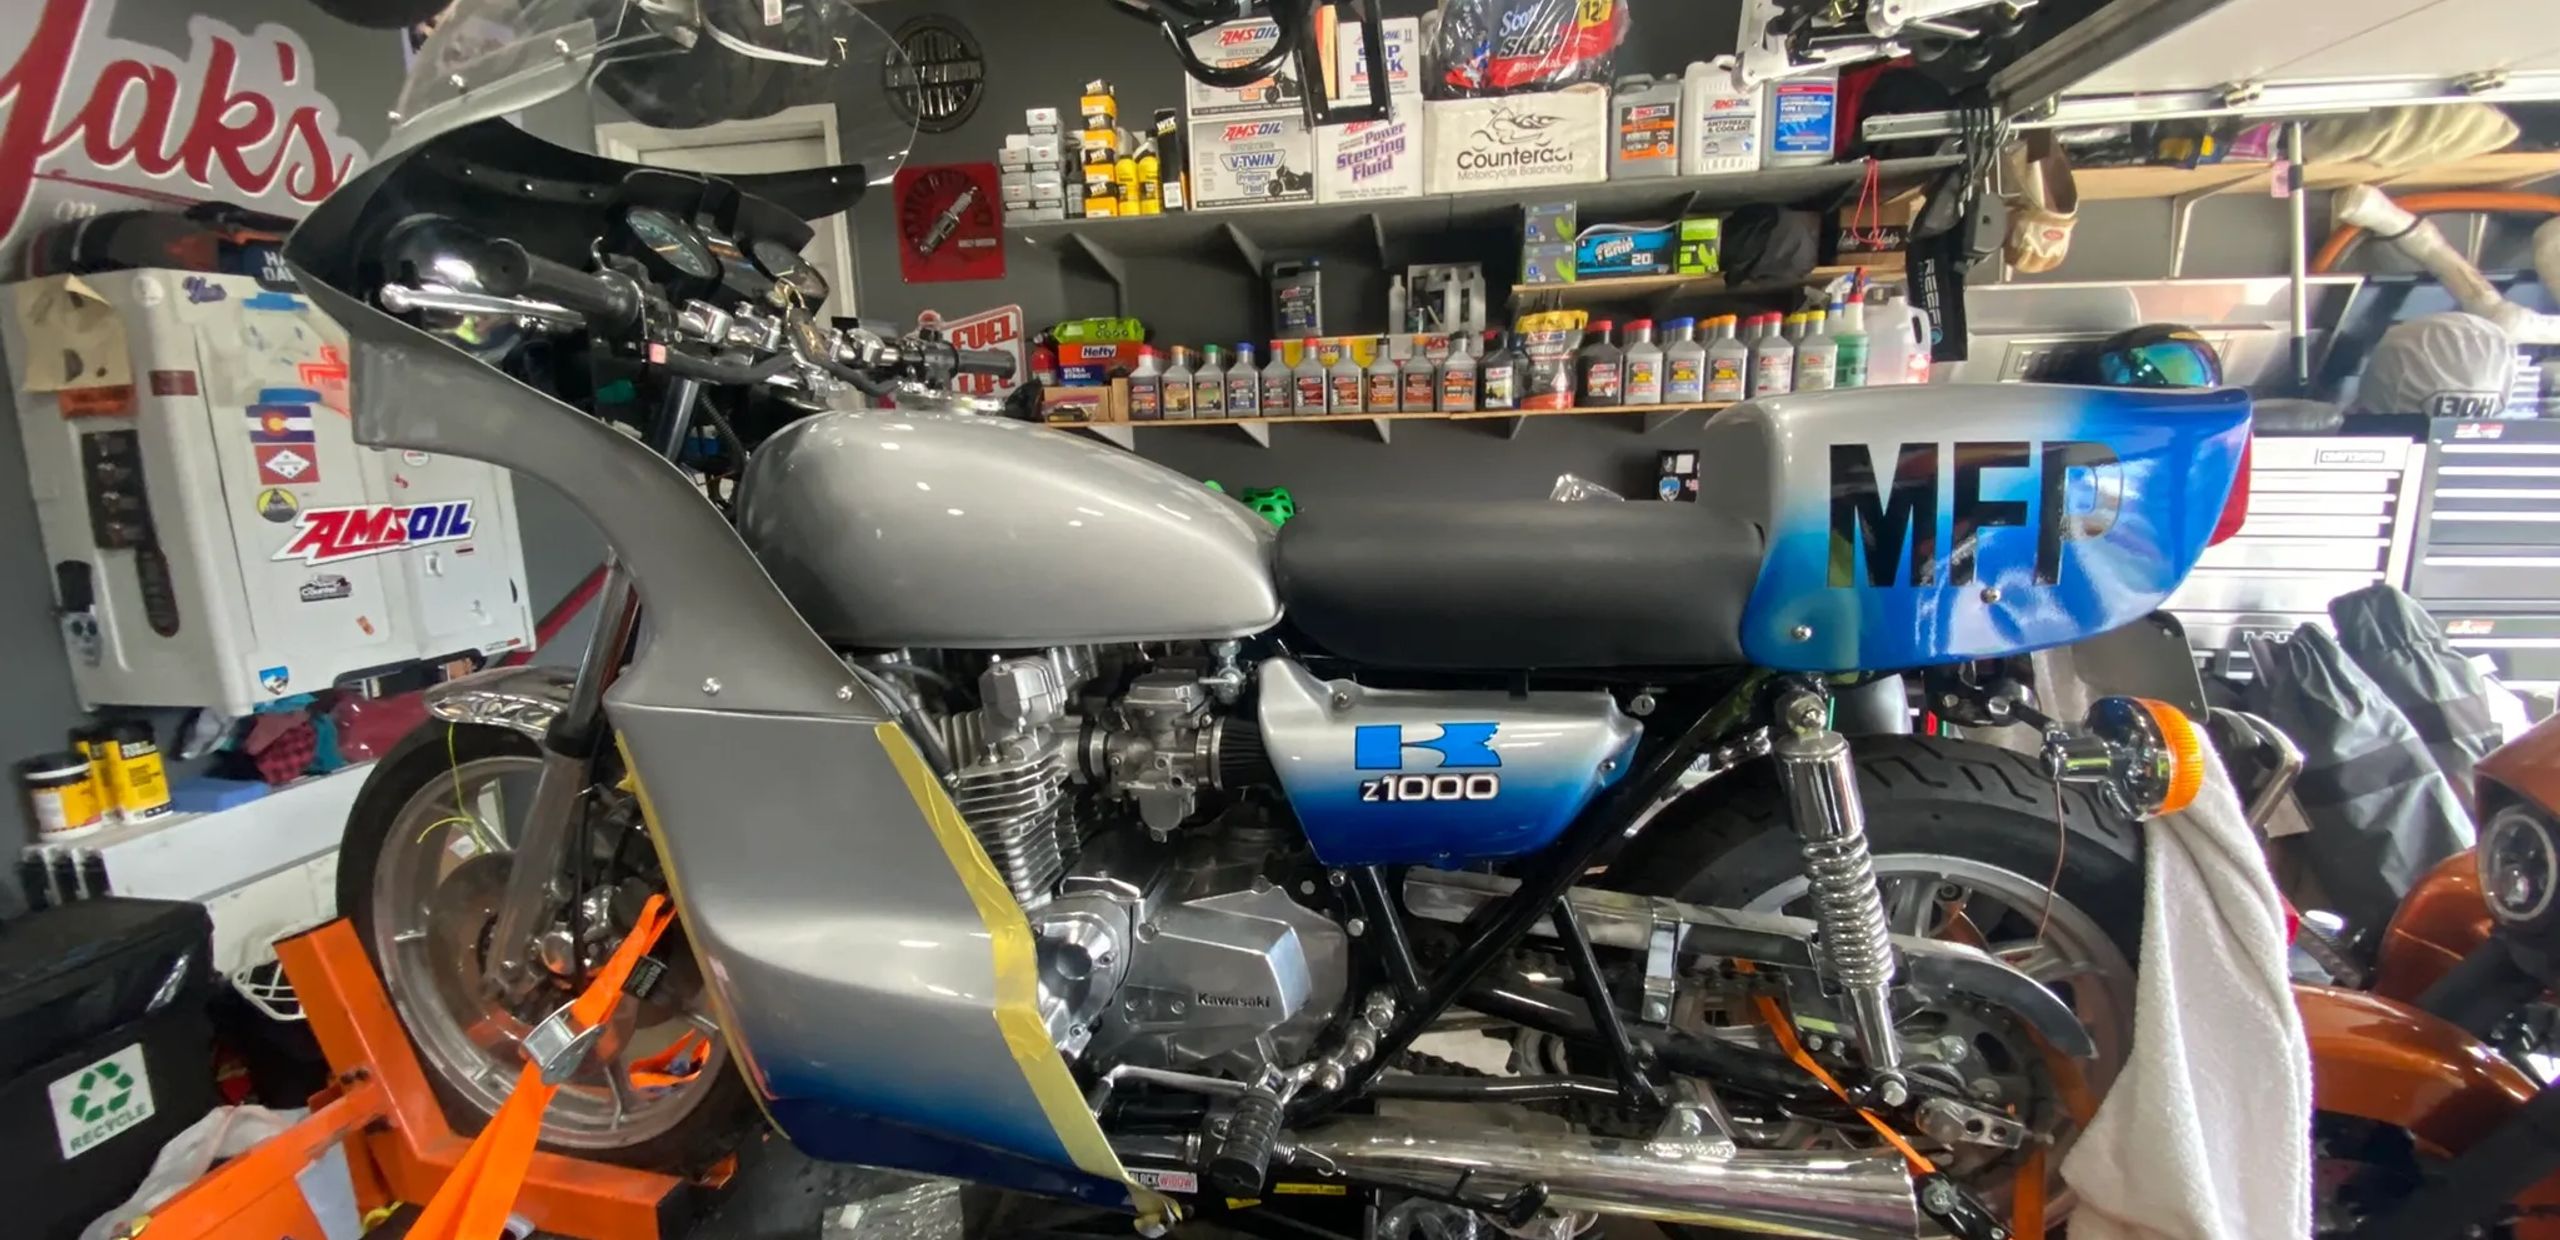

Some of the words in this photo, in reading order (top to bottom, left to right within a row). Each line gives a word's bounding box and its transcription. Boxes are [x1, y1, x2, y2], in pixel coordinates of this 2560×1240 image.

[1216, 26, 1279, 47] AMSOIL
[1220, 123, 1283, 142] AMSOIL
[1365, 123, 1406, 145] Power
[1230, 154, 1276, 168] V-TWIN
[1337, 136, 1406, 170] Steering
[1457, 147, 1573, 170] Counteract
[1352, 153, 1393, 182] Fluid
[1457, 167, 1518, 181] Motorcycle
[1520, 163, 1573, 177] Balancing
[1631, 253, 1653, 265] 20
[1924, 258, 1942, 326] REEF
[952, 315, 1018, 350] FUEL
[1083, 346, 1115, 357] Hefty
[1826, 440, 2124, 588] MFP
[286, 502, 472, 559] AMSOIL
[1196, 992, 1271, 1008] Kawasaki
[70, 1102, 146, 1151] RECYCLE
[1160, 1173, 1193, 1188] WIDOW
